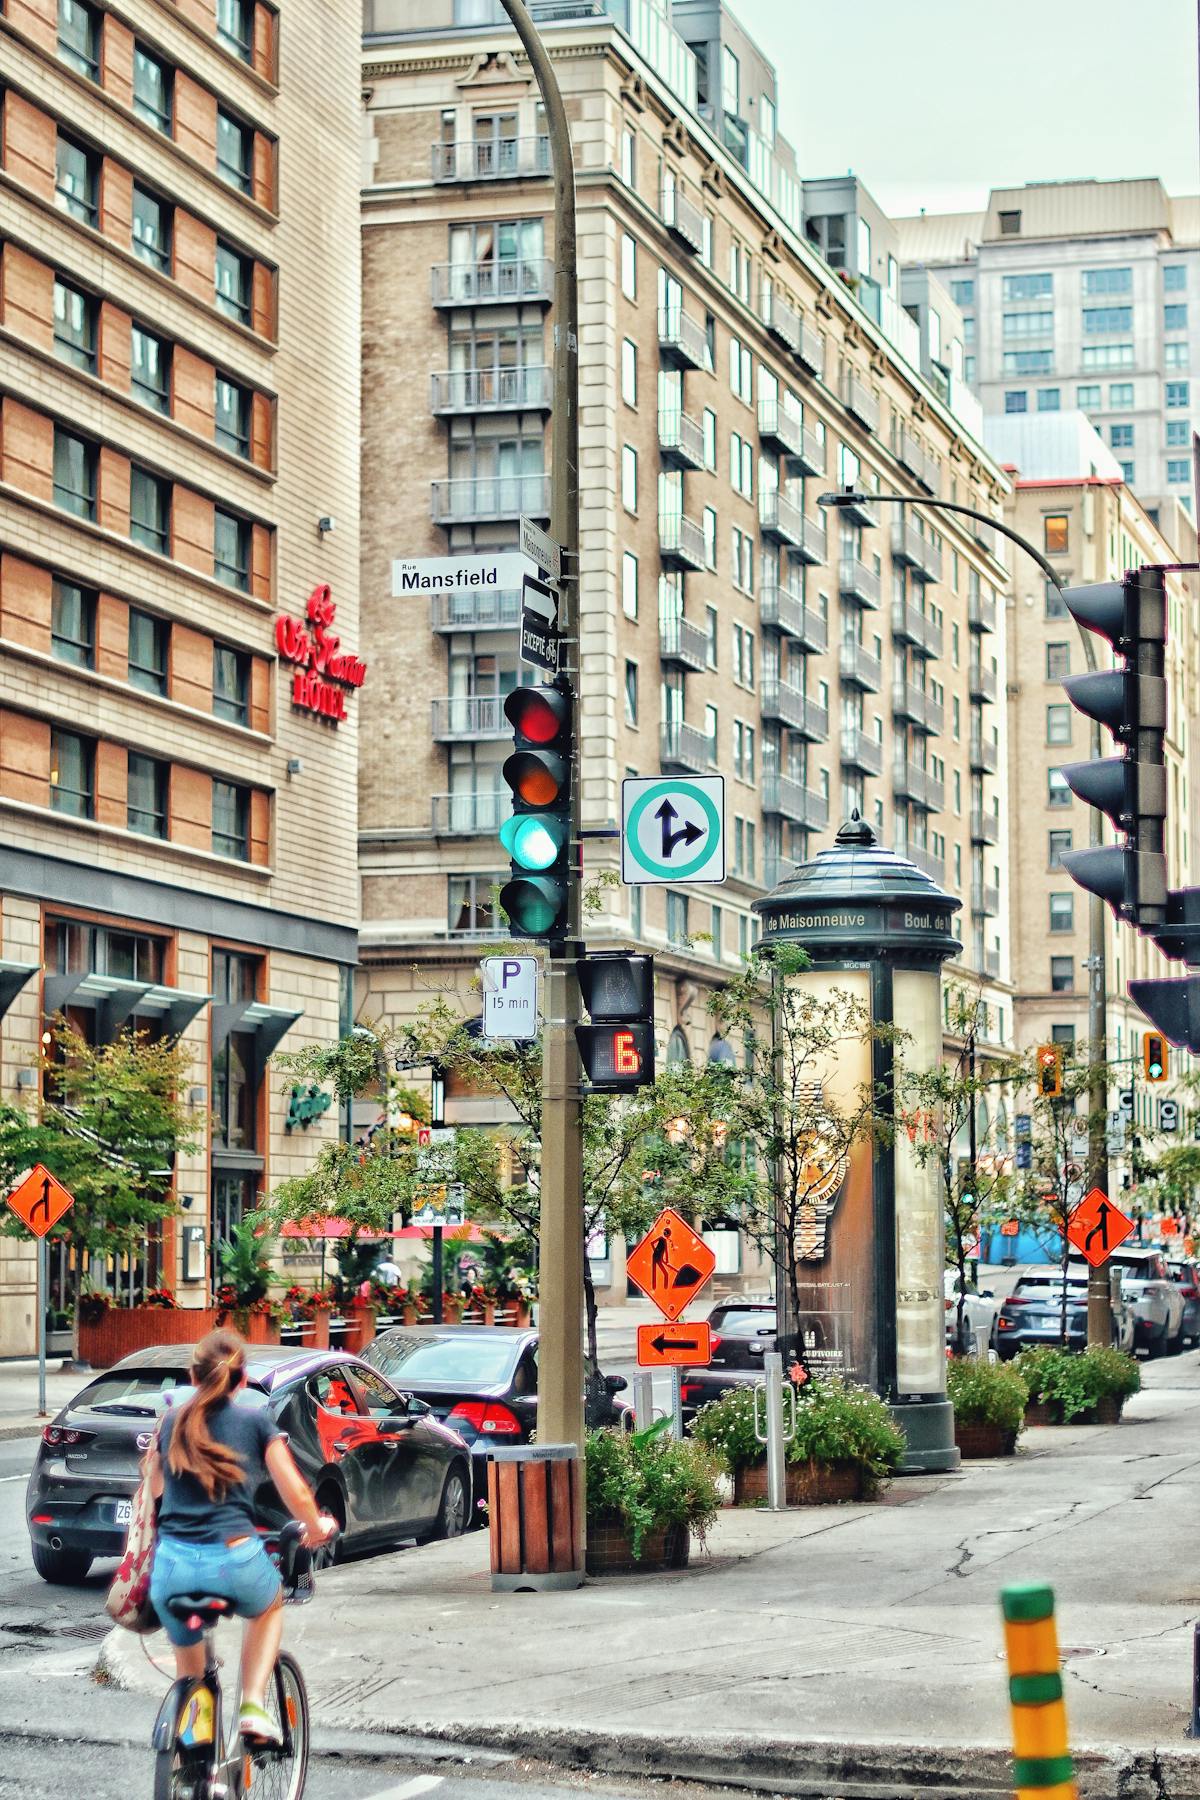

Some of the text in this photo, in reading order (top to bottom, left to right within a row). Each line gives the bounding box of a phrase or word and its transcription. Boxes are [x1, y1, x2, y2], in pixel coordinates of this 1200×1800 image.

[402, 568, 497, 590] Mansfield
[523, 629, 546, 656] EXCEPTÉ
[768, 917, 777, 931] de
[779, 913, 865, 930] Maisonneuve
[904, 912, 932, 928] Boul.
[934, 916, 944, 930] de
[502, 961, 521, 989] P
[493, 997, 529, 1009] 15 min
[614, 1032, 639, 1073] 6
